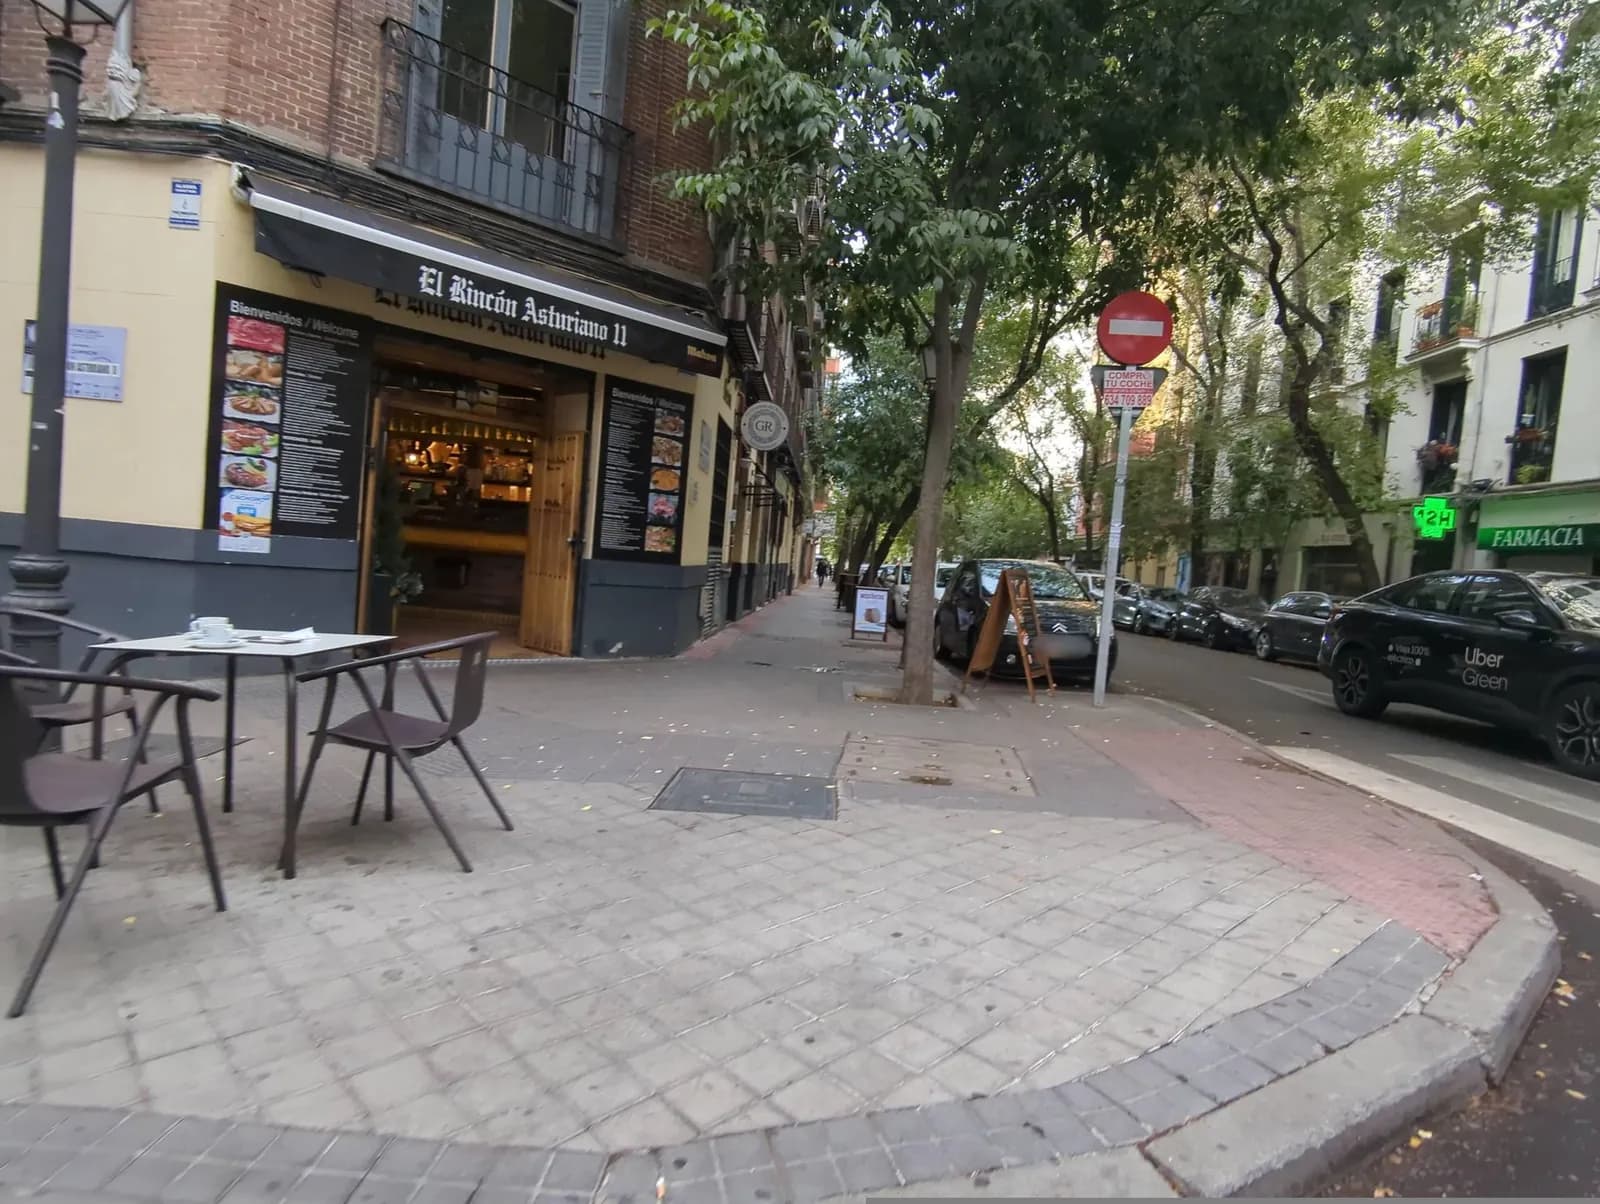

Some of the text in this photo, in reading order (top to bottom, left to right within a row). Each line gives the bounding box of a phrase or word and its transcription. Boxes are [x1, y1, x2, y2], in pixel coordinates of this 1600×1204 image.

[418, 265, 629, 347] El Rincón Asturiano 11
[229, 300, 303, 328] Bienvenidos
[311, 319, 360, 340] Welcome
[1105, 380, 1153, 388] TU COCHE
[1108, 371, 1149, 380] COMPR
[755, 420, 774, 433] GR
[1491, 527, 1584, 548] FARMACIA
[1464, 646, 1504, 669] Uber
[1462, 668, 1508, 692] Green
